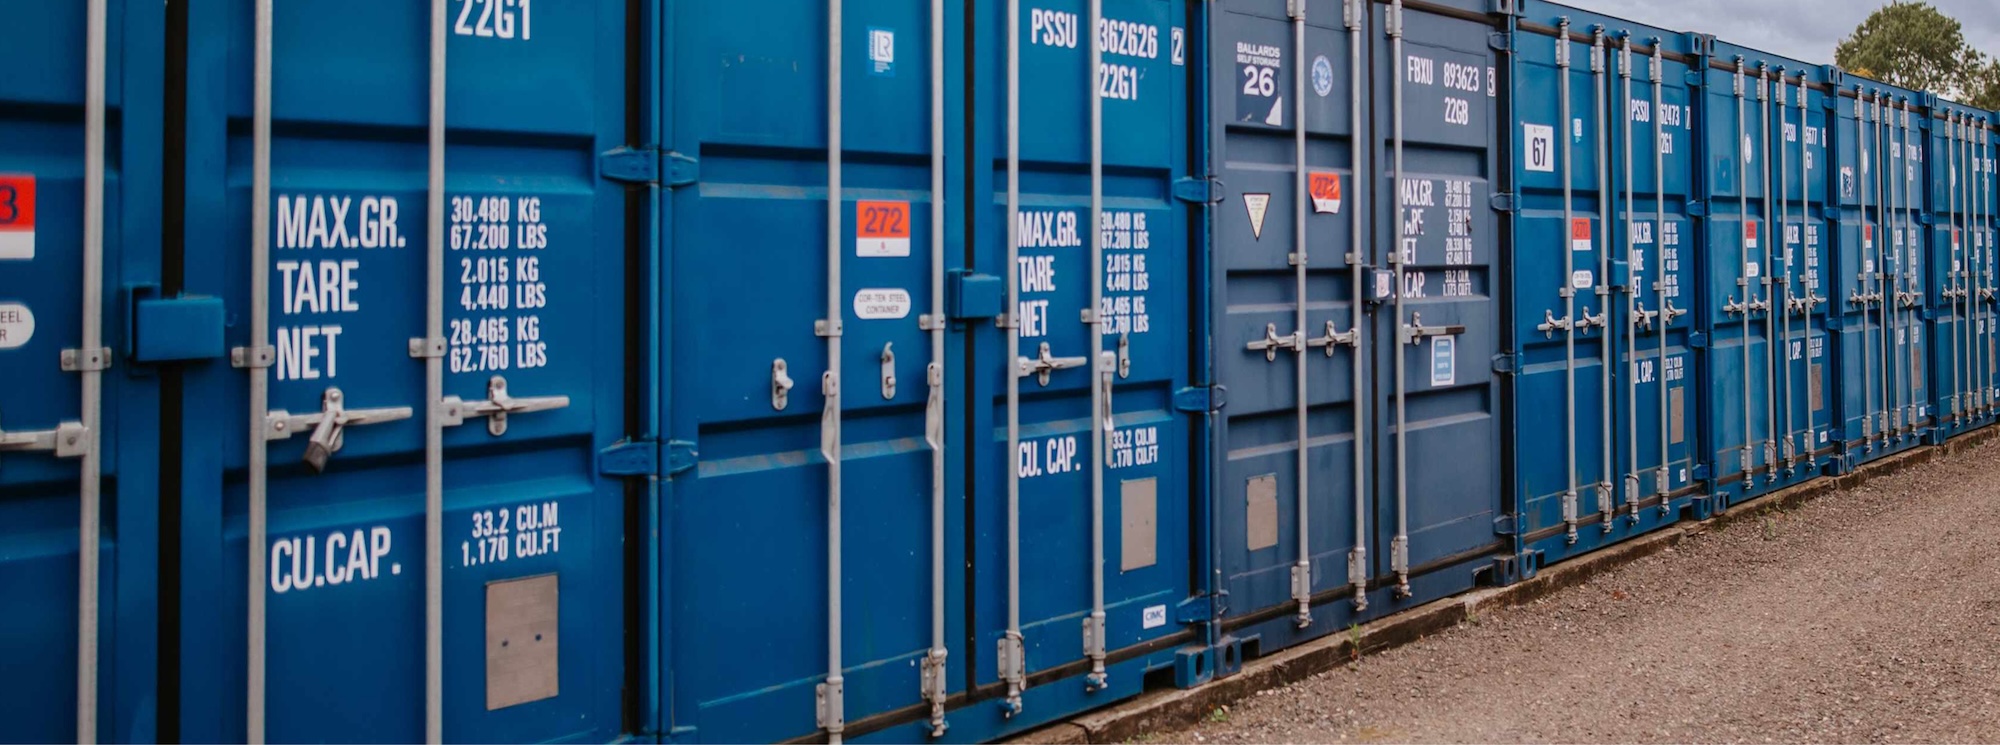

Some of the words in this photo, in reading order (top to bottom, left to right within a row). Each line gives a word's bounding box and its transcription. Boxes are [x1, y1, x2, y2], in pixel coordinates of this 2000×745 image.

[1031, 8, 1077, 49] PSSU
[1100, 18, 1158, 59] 362626
[1173, 29, 1183, 63] 2
[1237, 42, 1280, 58] BALLARDS
[1237, 54, 1252, 64] SELF
[1253, 56, 1280, 68] STORAGE
[1100, 62, 1137, 100] 22G1
[1243, 65, 1275, 97] 26
[1407, 55, 1433, 85] FBXU
[1443, 61, 1479, 92] 893623
[1487, 69, 1495, 95] 3
[1631, 99, 1649, 122] PSSU
[1532, 136, 1546, 167] 67
[1661, 132, 1672, 154] 2G1
[276, 194, 406, 249] MAX.GR.
[517, 196, 540, 223] KG
[864, 206, 903, 234] 272
[1133, 212, 1146, 230] KG
[516, 223, 547, 249] LBS
[1018, 211, 1081, 247] MAX.GR.
[1133, 231, 1149, 249] LBS
[516, 256, 539, 282] KG
[1133, 254, 1145, 272] KG
[1633, 248, 1644, 271] ARE
[276, 259, 360, 314] TARE
[1018, 255, 1056, 292] TARE
[1132, 272, 1149, 291] LBS
[1633, 275, 1642, 298] ET
[515, 282, 546, 309] LBS
[1133, 295, 1145, 314] KG
[866, 305, 900, 314] CONTAINER
[1020, 299, 1049, 337] NET
[516, 315, 540, 342] KG
[1132, 314, 1149, 333] LBS
[276, 324, 343, 381] NET
[516, 342, 547, 369] LBS
[1112, 429, 1132, 449] 33.2
[1135, 426, 1157, 445] CU.M
[1018, 441, 1042, 478] CU.
[1046, 436, 1081, 474] CAP.
[1135, 445, 1159, 466] CU.FT
[472, 507, 509, 538] 33.2
[516, 501, 558, 531] CU.M
[515, 527, 562, 558] CU.FT
[270, 525, 402, 593] CU.CAP.
